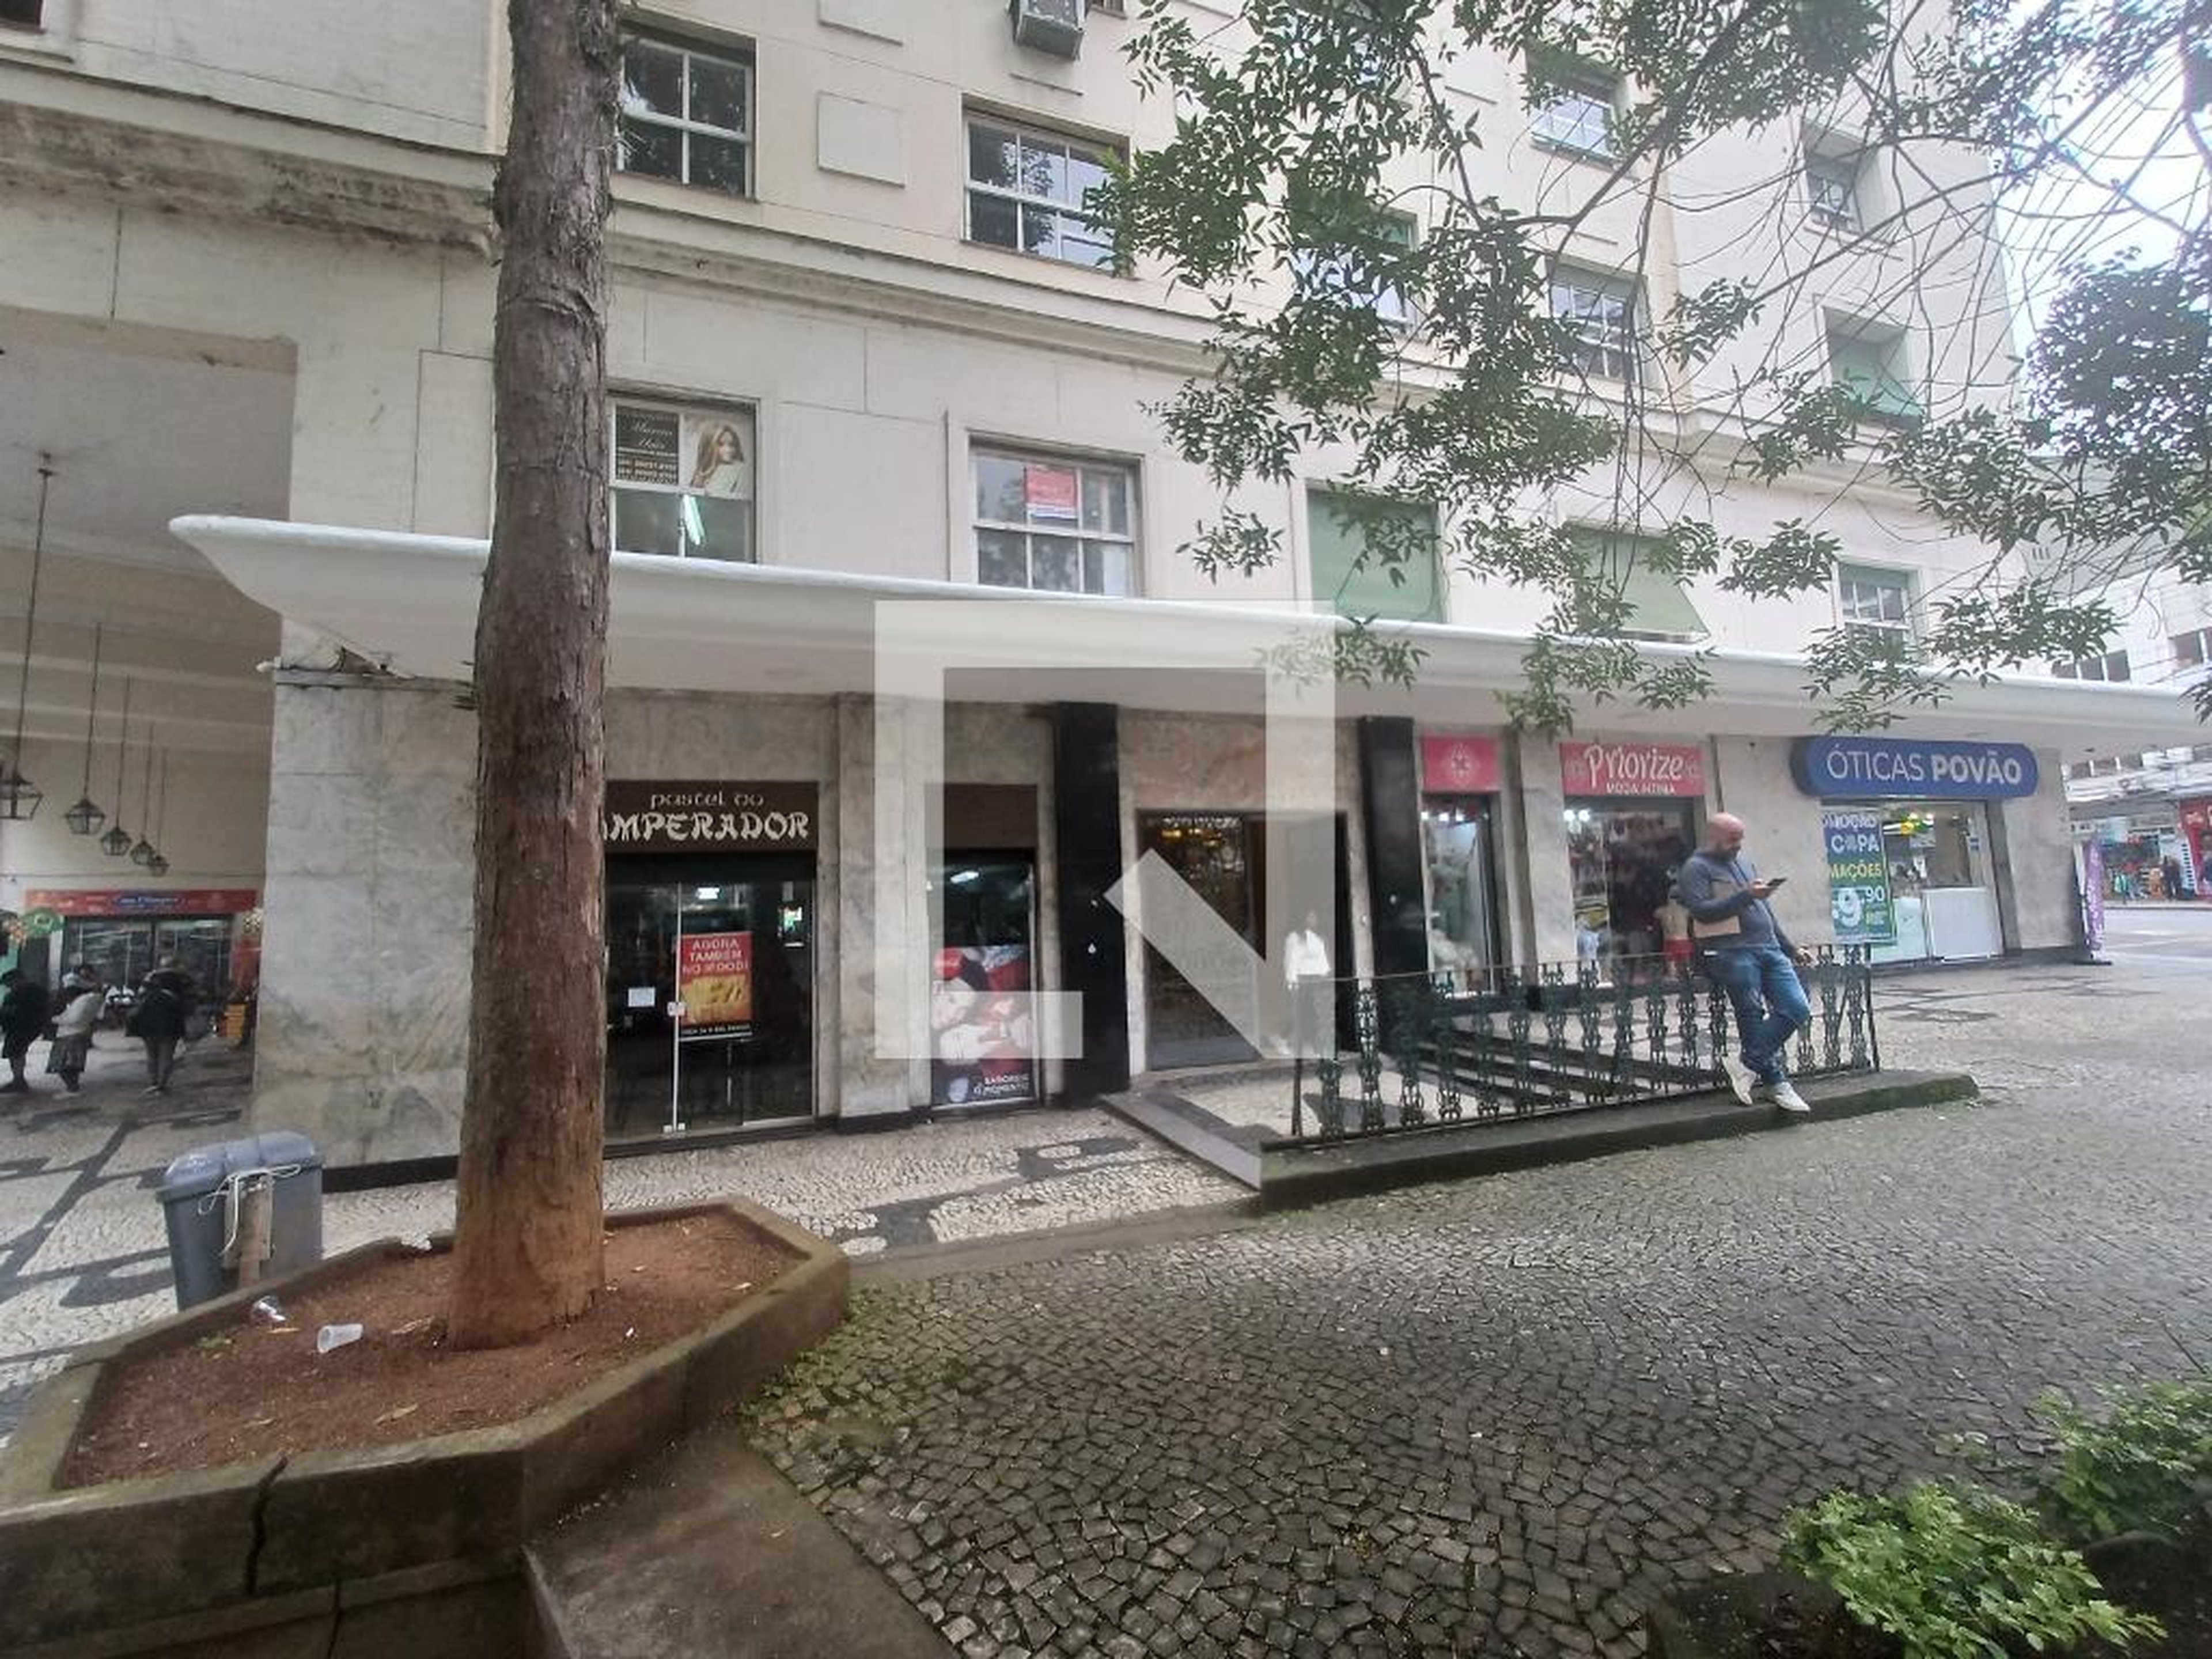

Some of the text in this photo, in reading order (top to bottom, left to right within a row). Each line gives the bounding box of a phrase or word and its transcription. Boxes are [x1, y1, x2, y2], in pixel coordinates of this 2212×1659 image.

[1585, 745, 1684, 789] Priorize
[1827, 744, 2022, 785] ÓTICAS POVÃO
